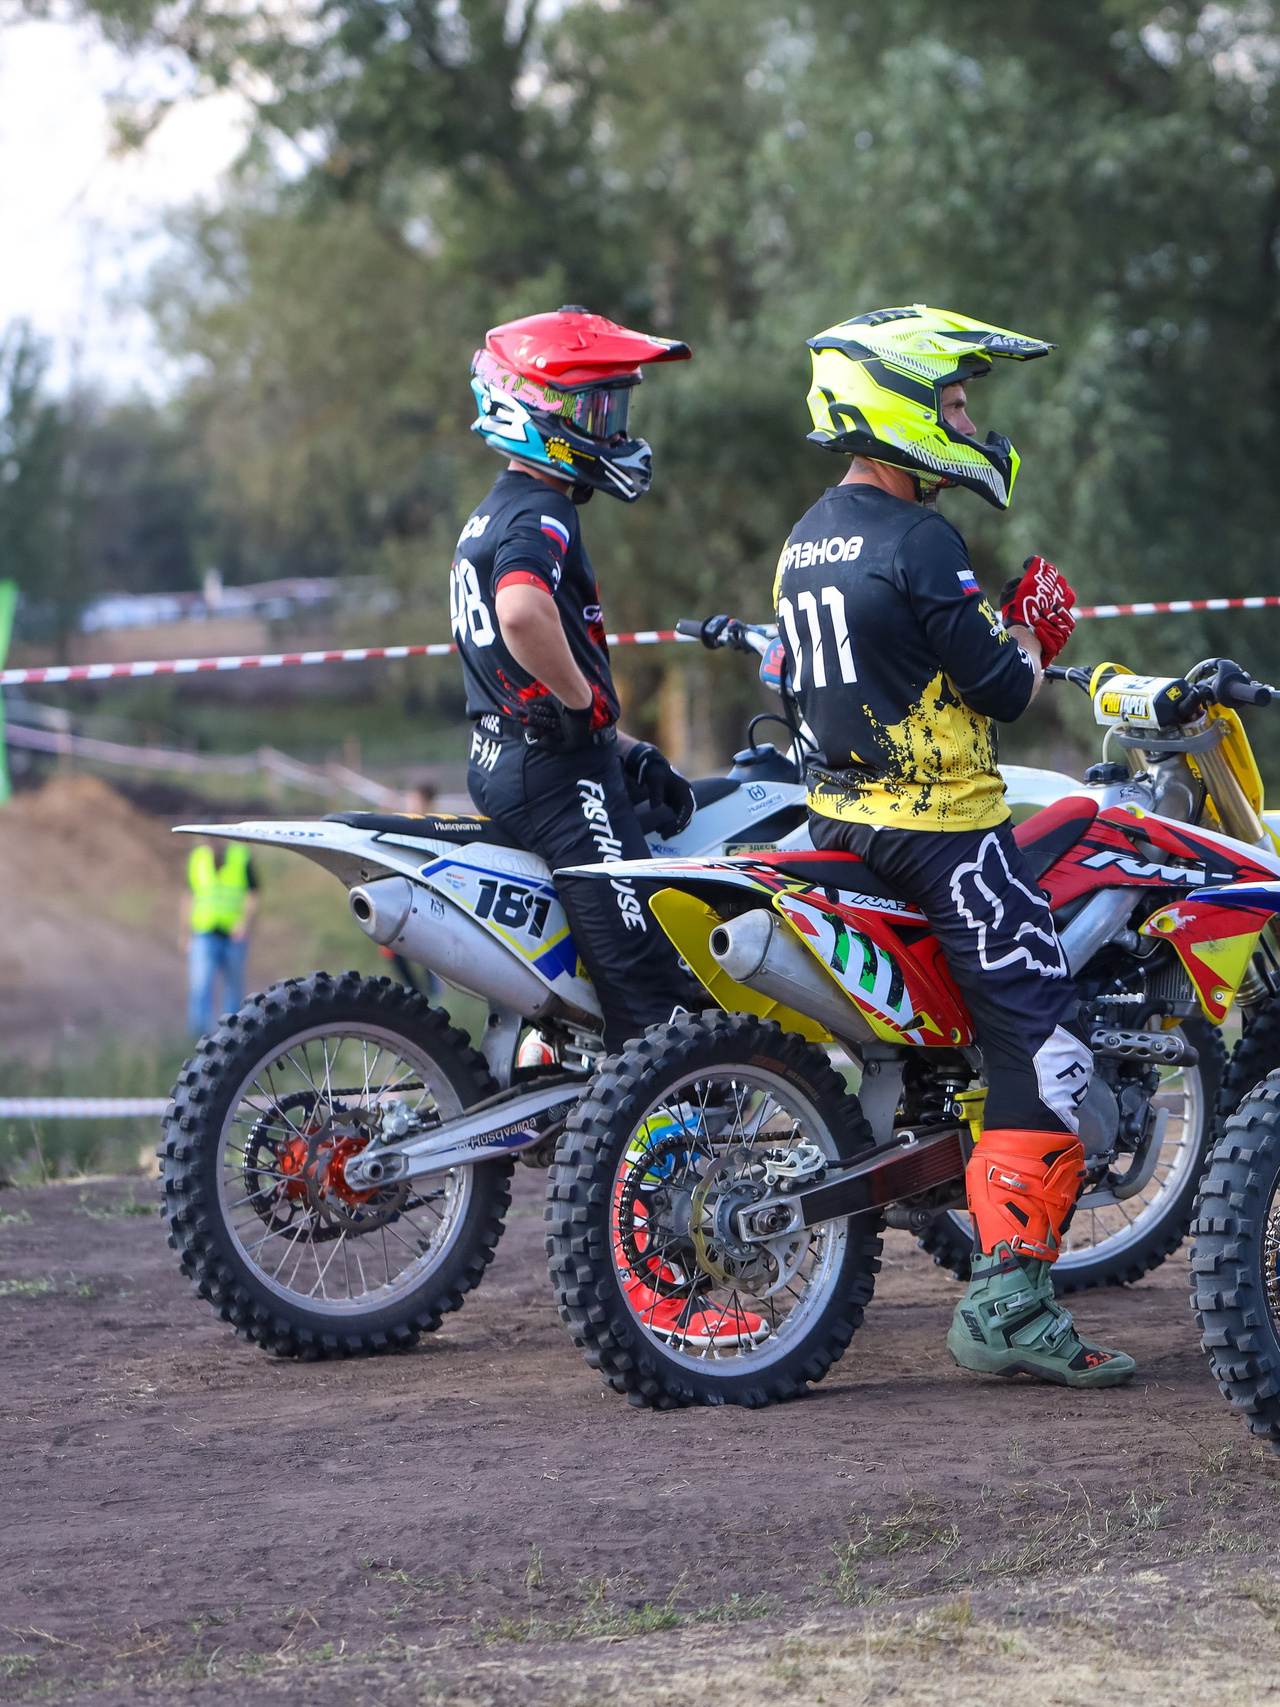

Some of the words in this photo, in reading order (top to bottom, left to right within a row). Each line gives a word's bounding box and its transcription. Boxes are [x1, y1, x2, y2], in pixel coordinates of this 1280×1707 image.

[778, 585, 858, 693] 111
[434, 822, 482, 833] Husqvarna
[474, 878, 552, 939] 181
[469, 1117, 537, 1150] Husqvarna
